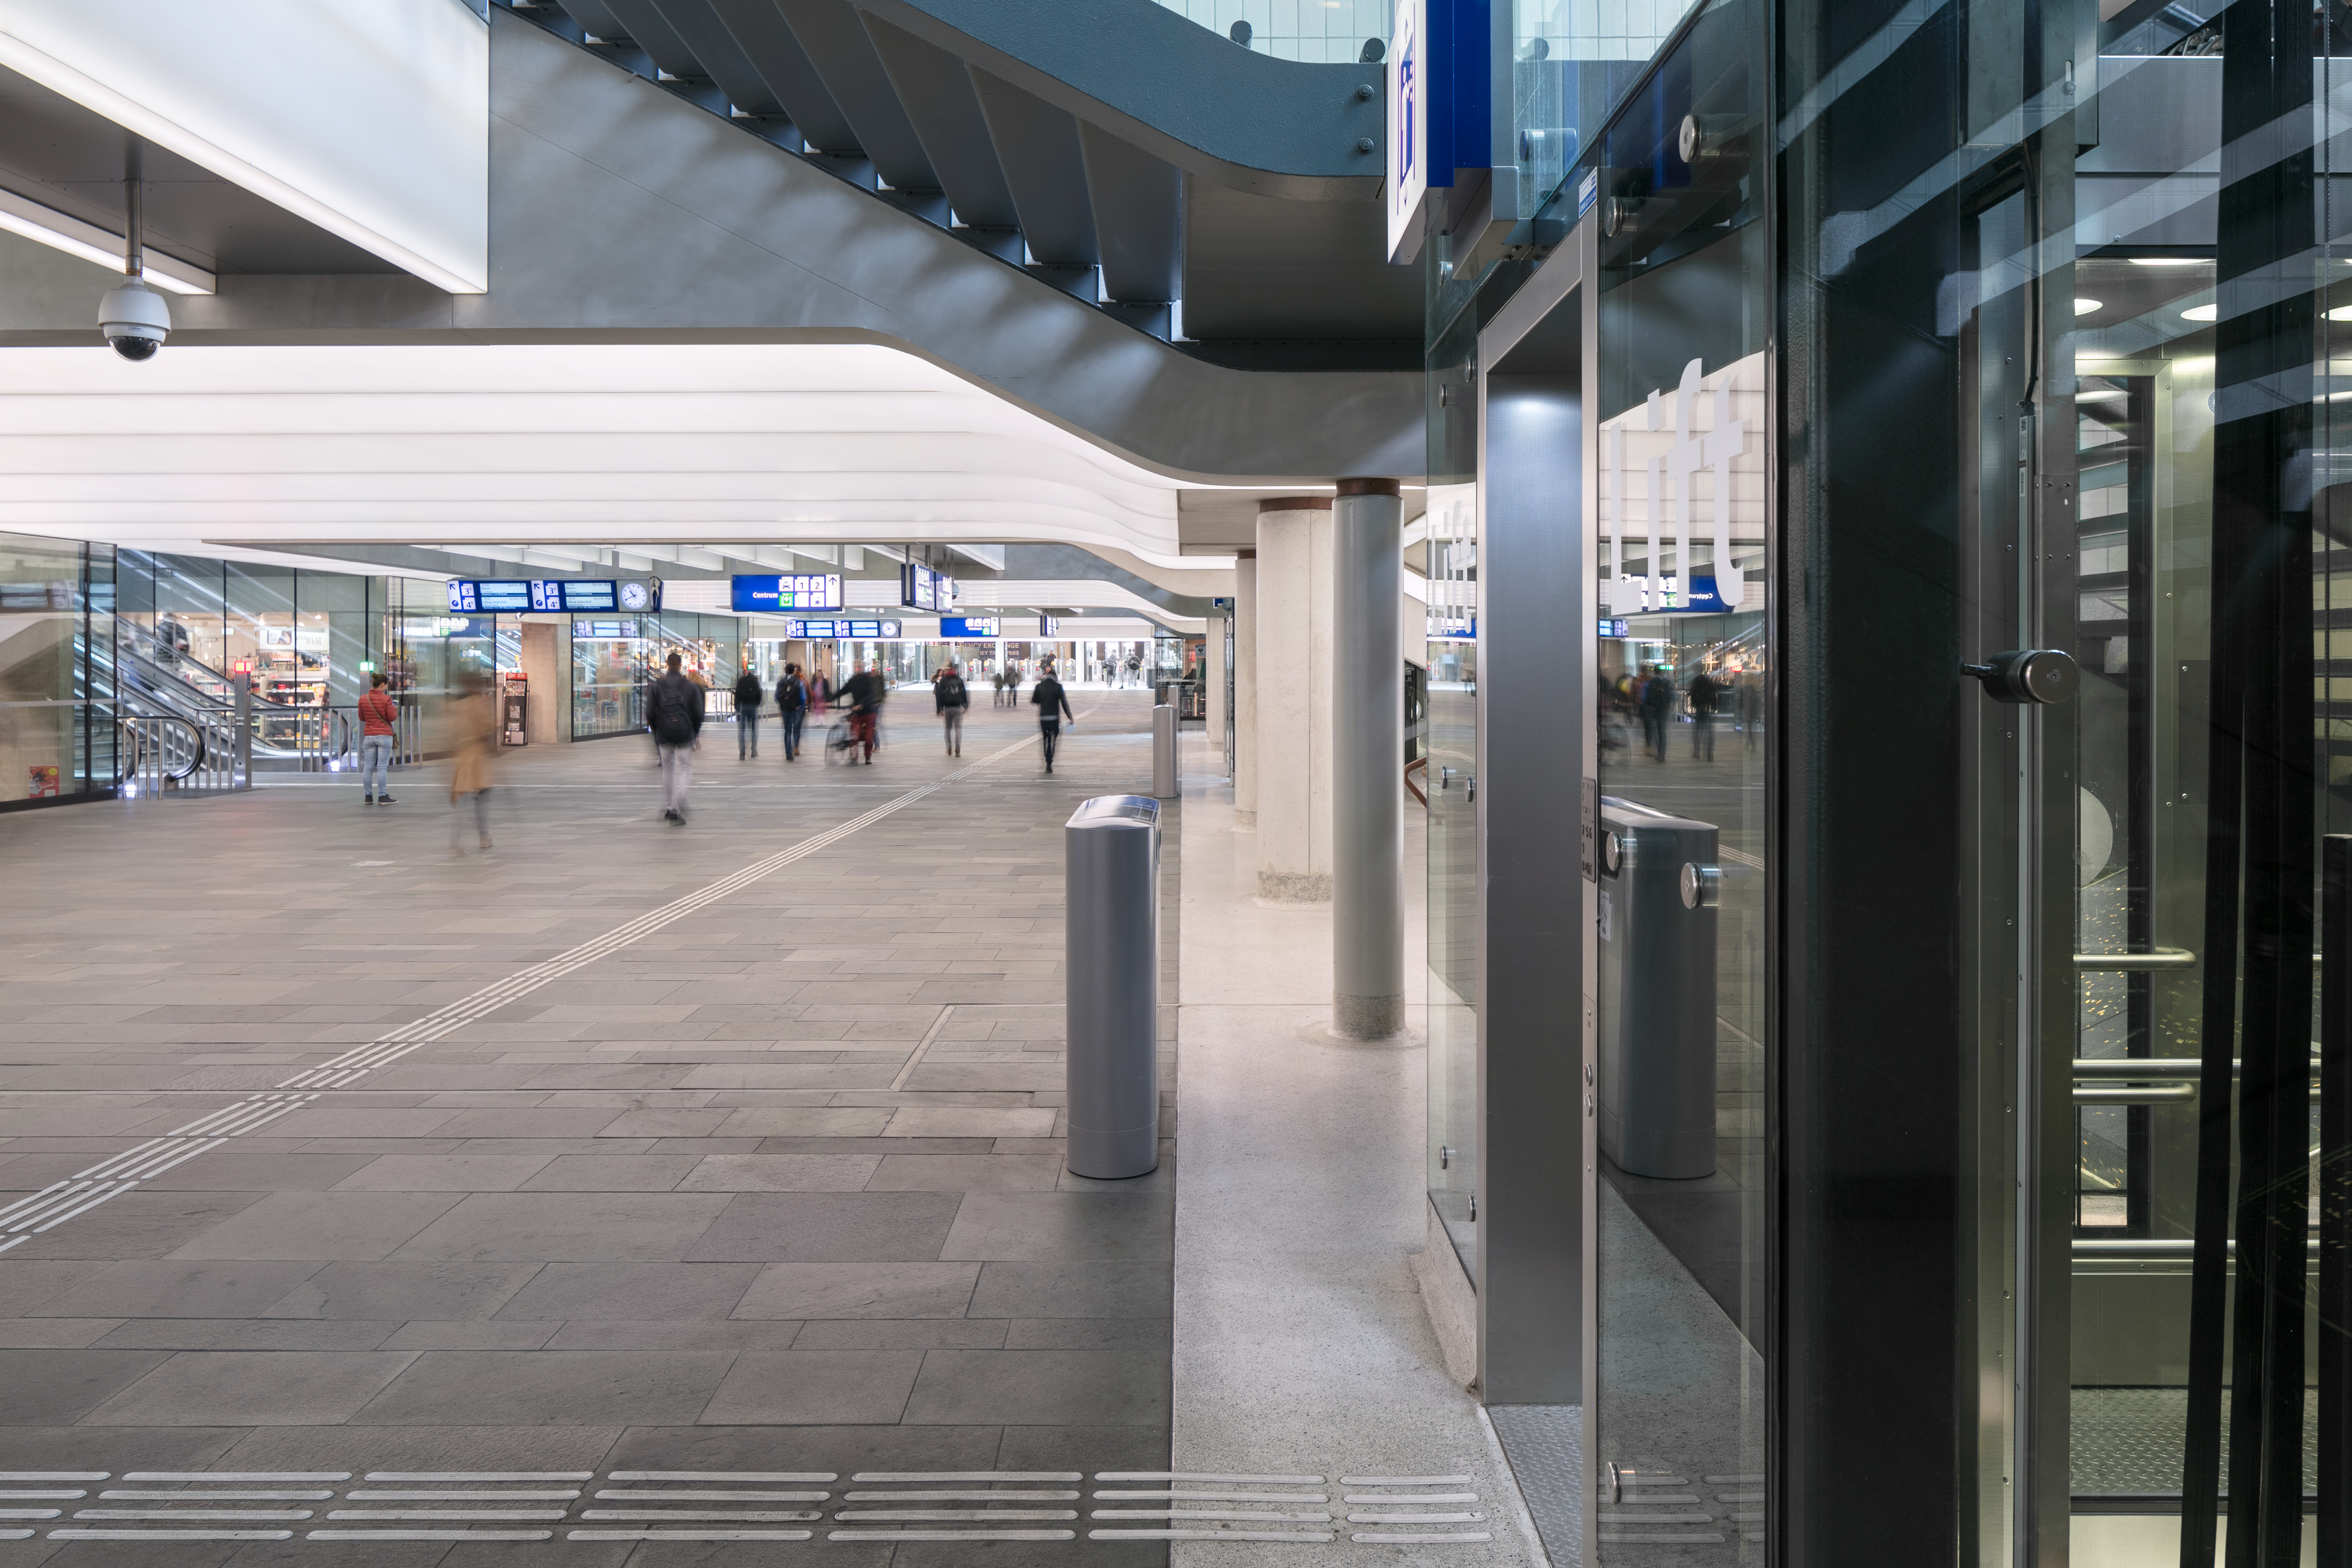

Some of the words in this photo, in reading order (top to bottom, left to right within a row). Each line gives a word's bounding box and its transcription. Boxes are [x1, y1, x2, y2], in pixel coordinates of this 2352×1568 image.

[1611, 358, 1744, 616] Lift
[1432, 500, 1472, 636] Lift
[306, 637, 321, 645] HAAR
[1582, 842, 1585, 854] 1
